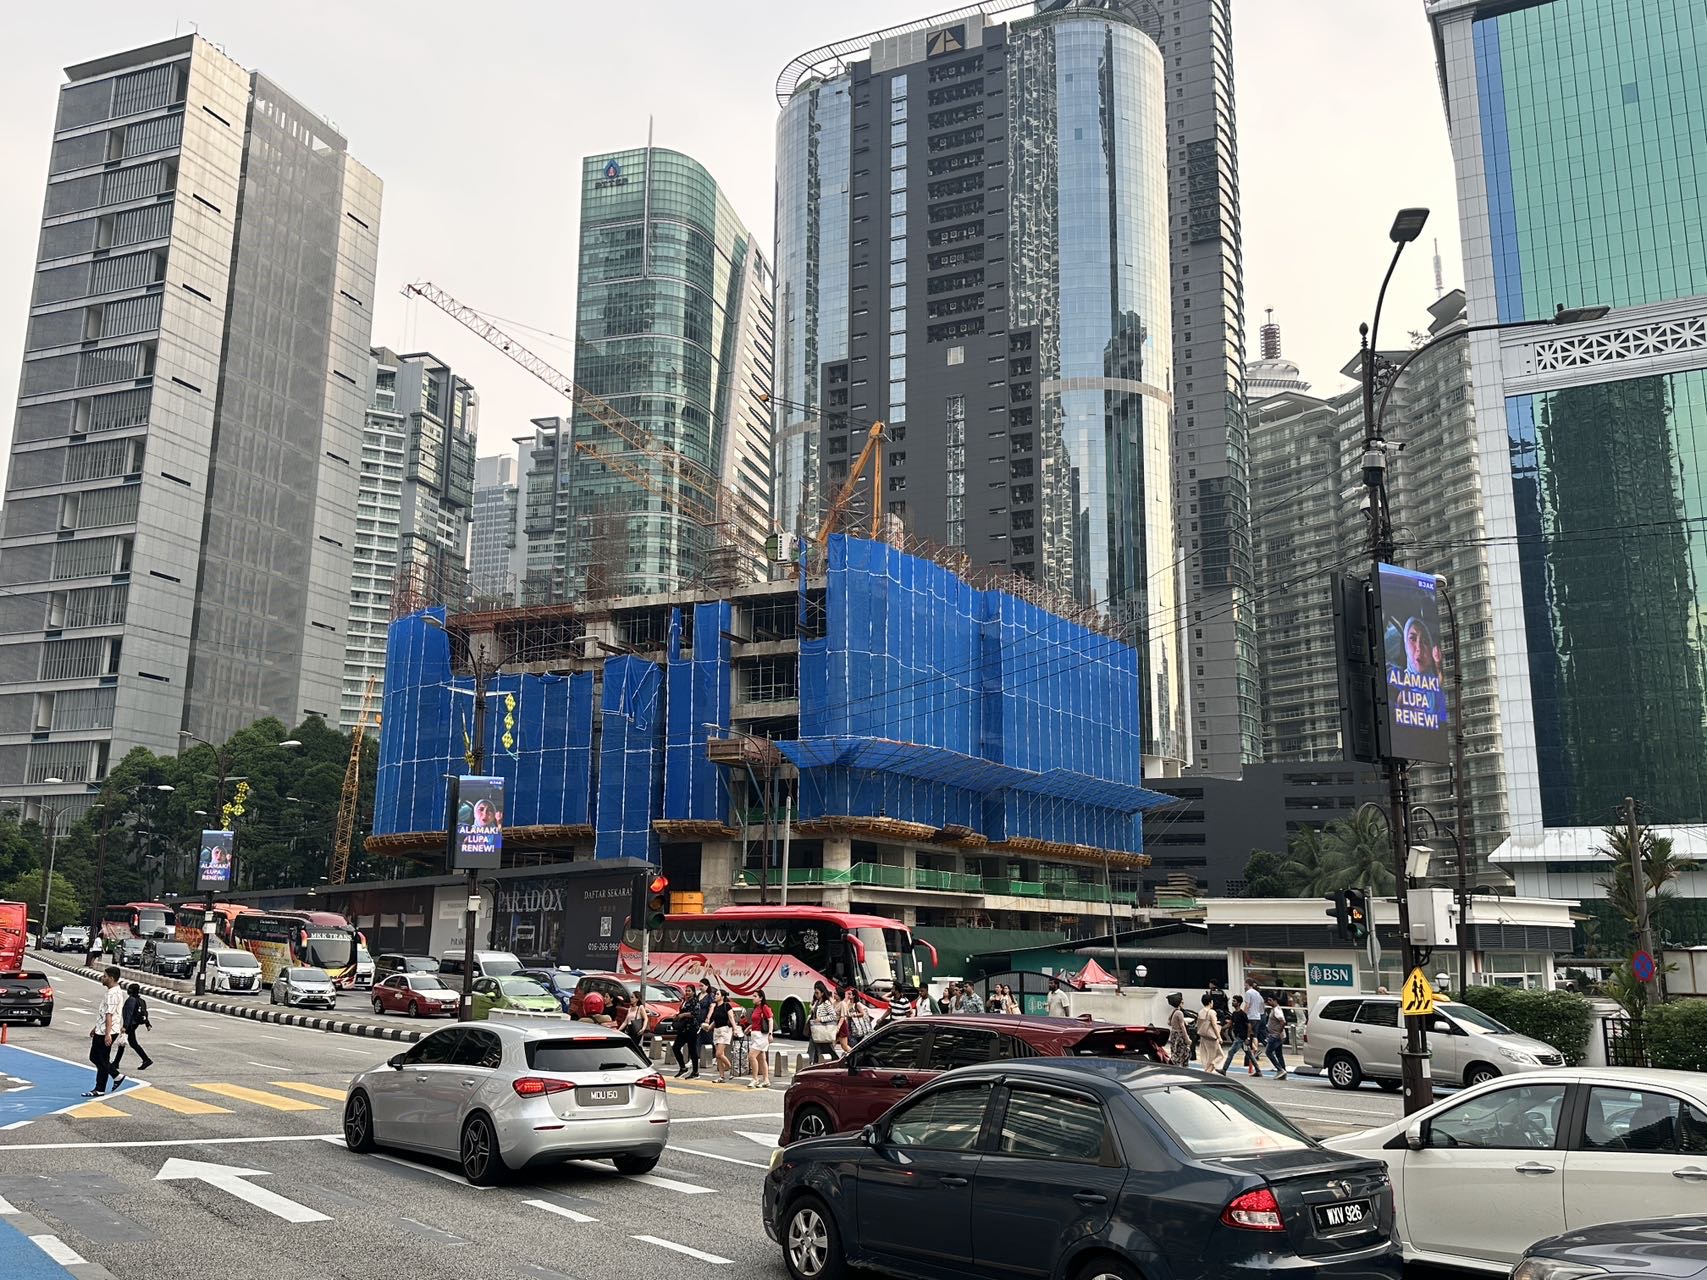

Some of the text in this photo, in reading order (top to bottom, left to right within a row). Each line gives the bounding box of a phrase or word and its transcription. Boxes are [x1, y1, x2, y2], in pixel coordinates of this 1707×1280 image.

[1389, 670, 1440, 692] ALAMAK!
[1402, 692, 1430, 708] LUPA
[1395, 708, 1439, 729] RENEW!
[459, 826, 499, 834] ALAMAK!
[468, 835, 489, 843] LUPA
[461, 844, 495, 853] RENEW!
[497, 888, 563, 912] PARADOX
[584, 890, 607, 899] DAFTAR
[1323, 969, 1348, 981] BSN
[590, 1090, 606, 1100] MDU
[1326, 1204, 1363, 1225] WXV 926
